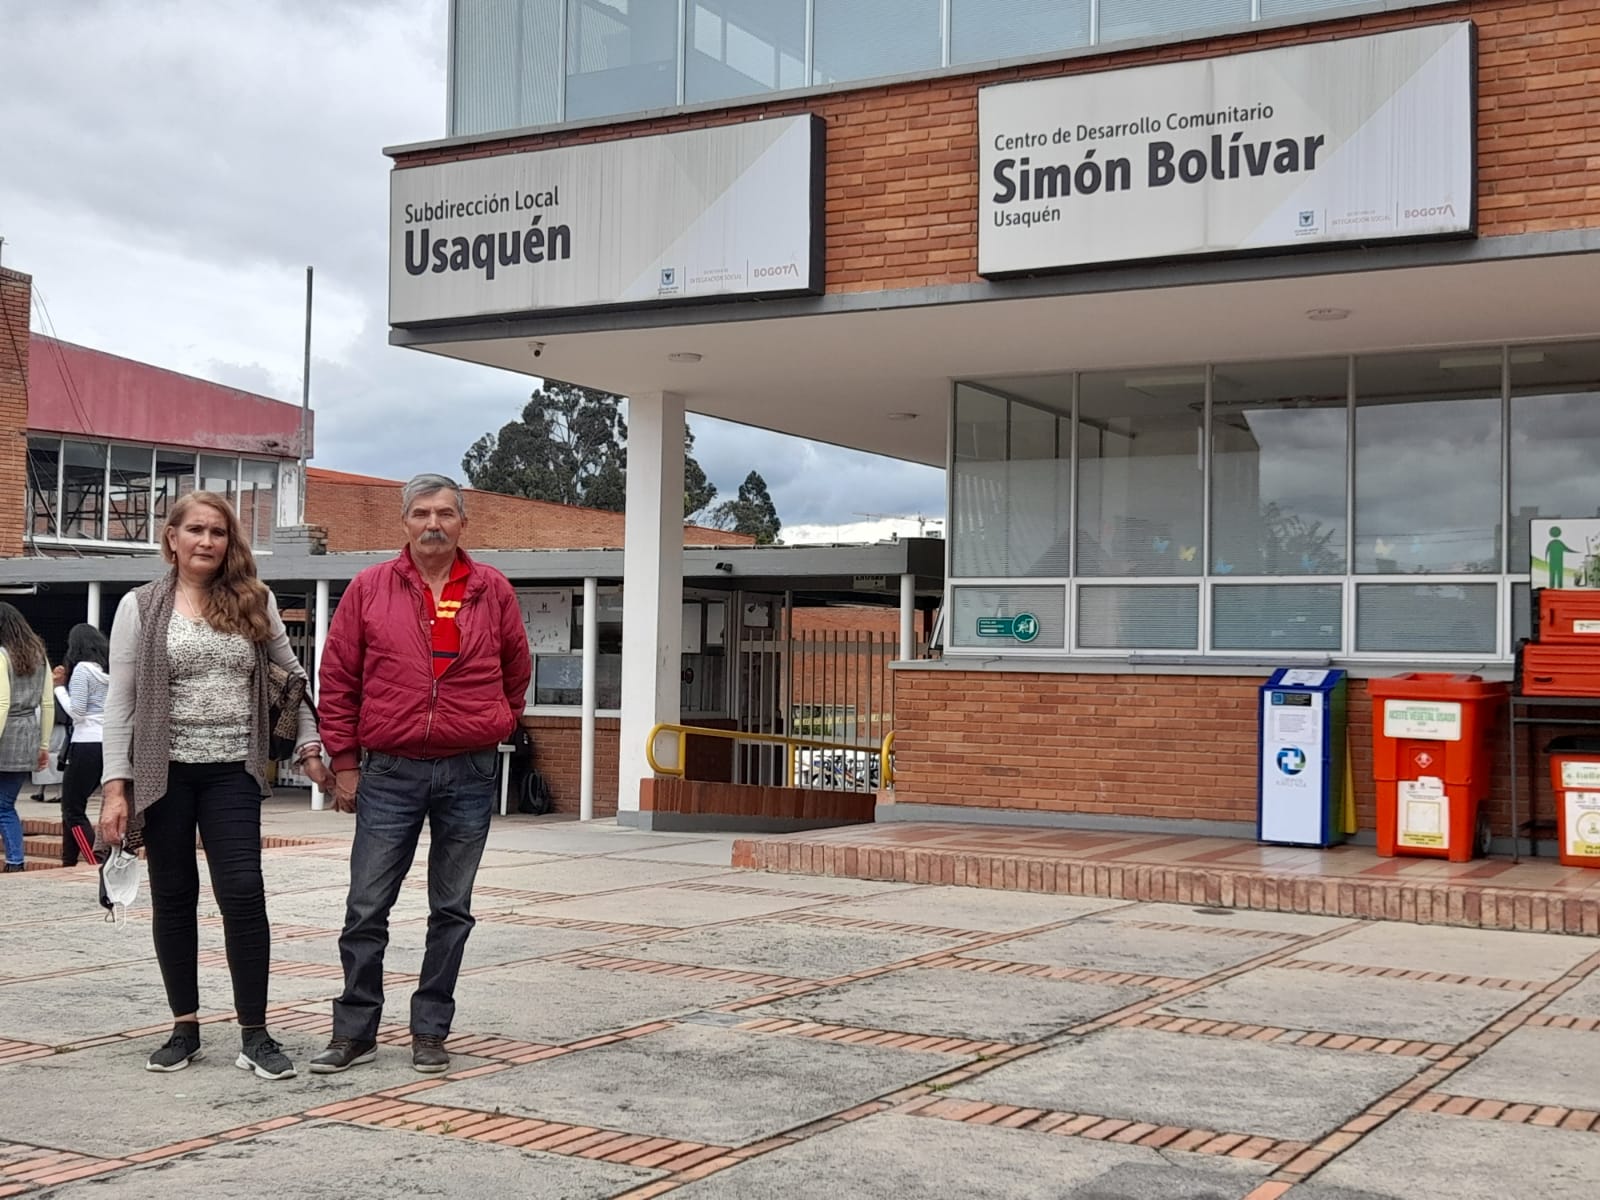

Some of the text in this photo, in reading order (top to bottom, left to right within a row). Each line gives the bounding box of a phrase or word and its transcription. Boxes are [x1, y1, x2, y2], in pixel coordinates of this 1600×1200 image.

[994, 102, 1274, 151] Centro de Desarrollo Comunitario
[992, 131, 1325, 204] Simón Bolívar
[405, 185, 559, 224] Subdirección Local
[994, 205, 1061, 228] Usaquén
[405, 214, 571, 280] Usaquén
